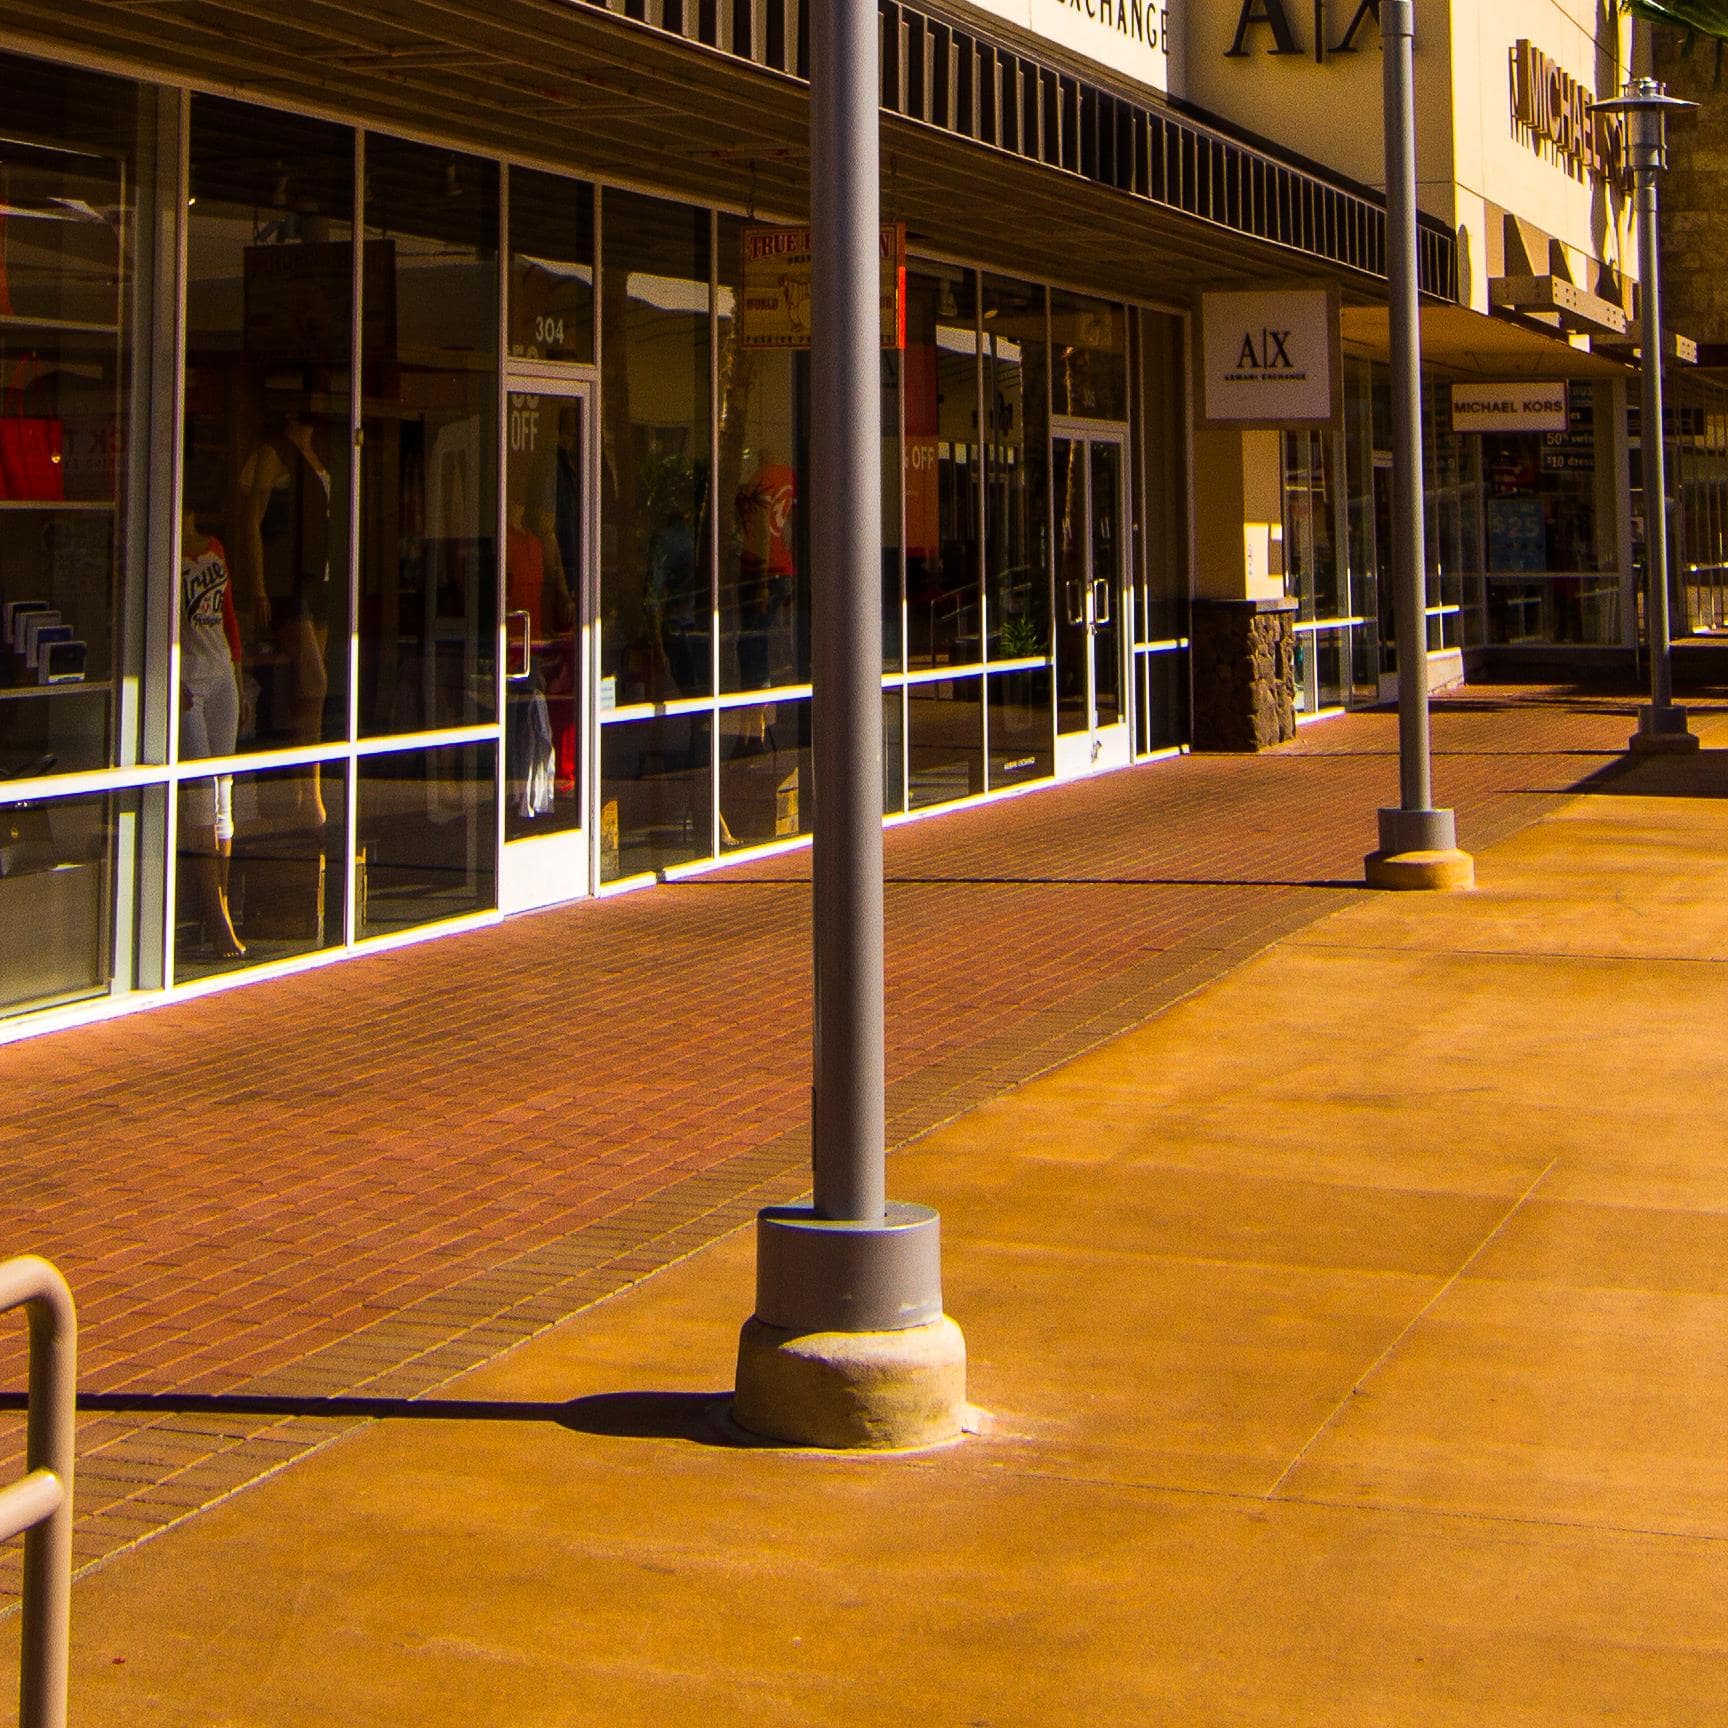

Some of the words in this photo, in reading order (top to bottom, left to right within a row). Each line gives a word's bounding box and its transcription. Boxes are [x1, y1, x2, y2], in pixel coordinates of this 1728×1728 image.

[750, 233, 797, 260] TRUE
[535, 315, 564, 344] 304
[1454, 401, 1517, 414] MICHAEL
[1523, 400, 1563, 413] KORS
[511, 411, 540, 452] OFF
[911, 445, 935, 470] OFF
